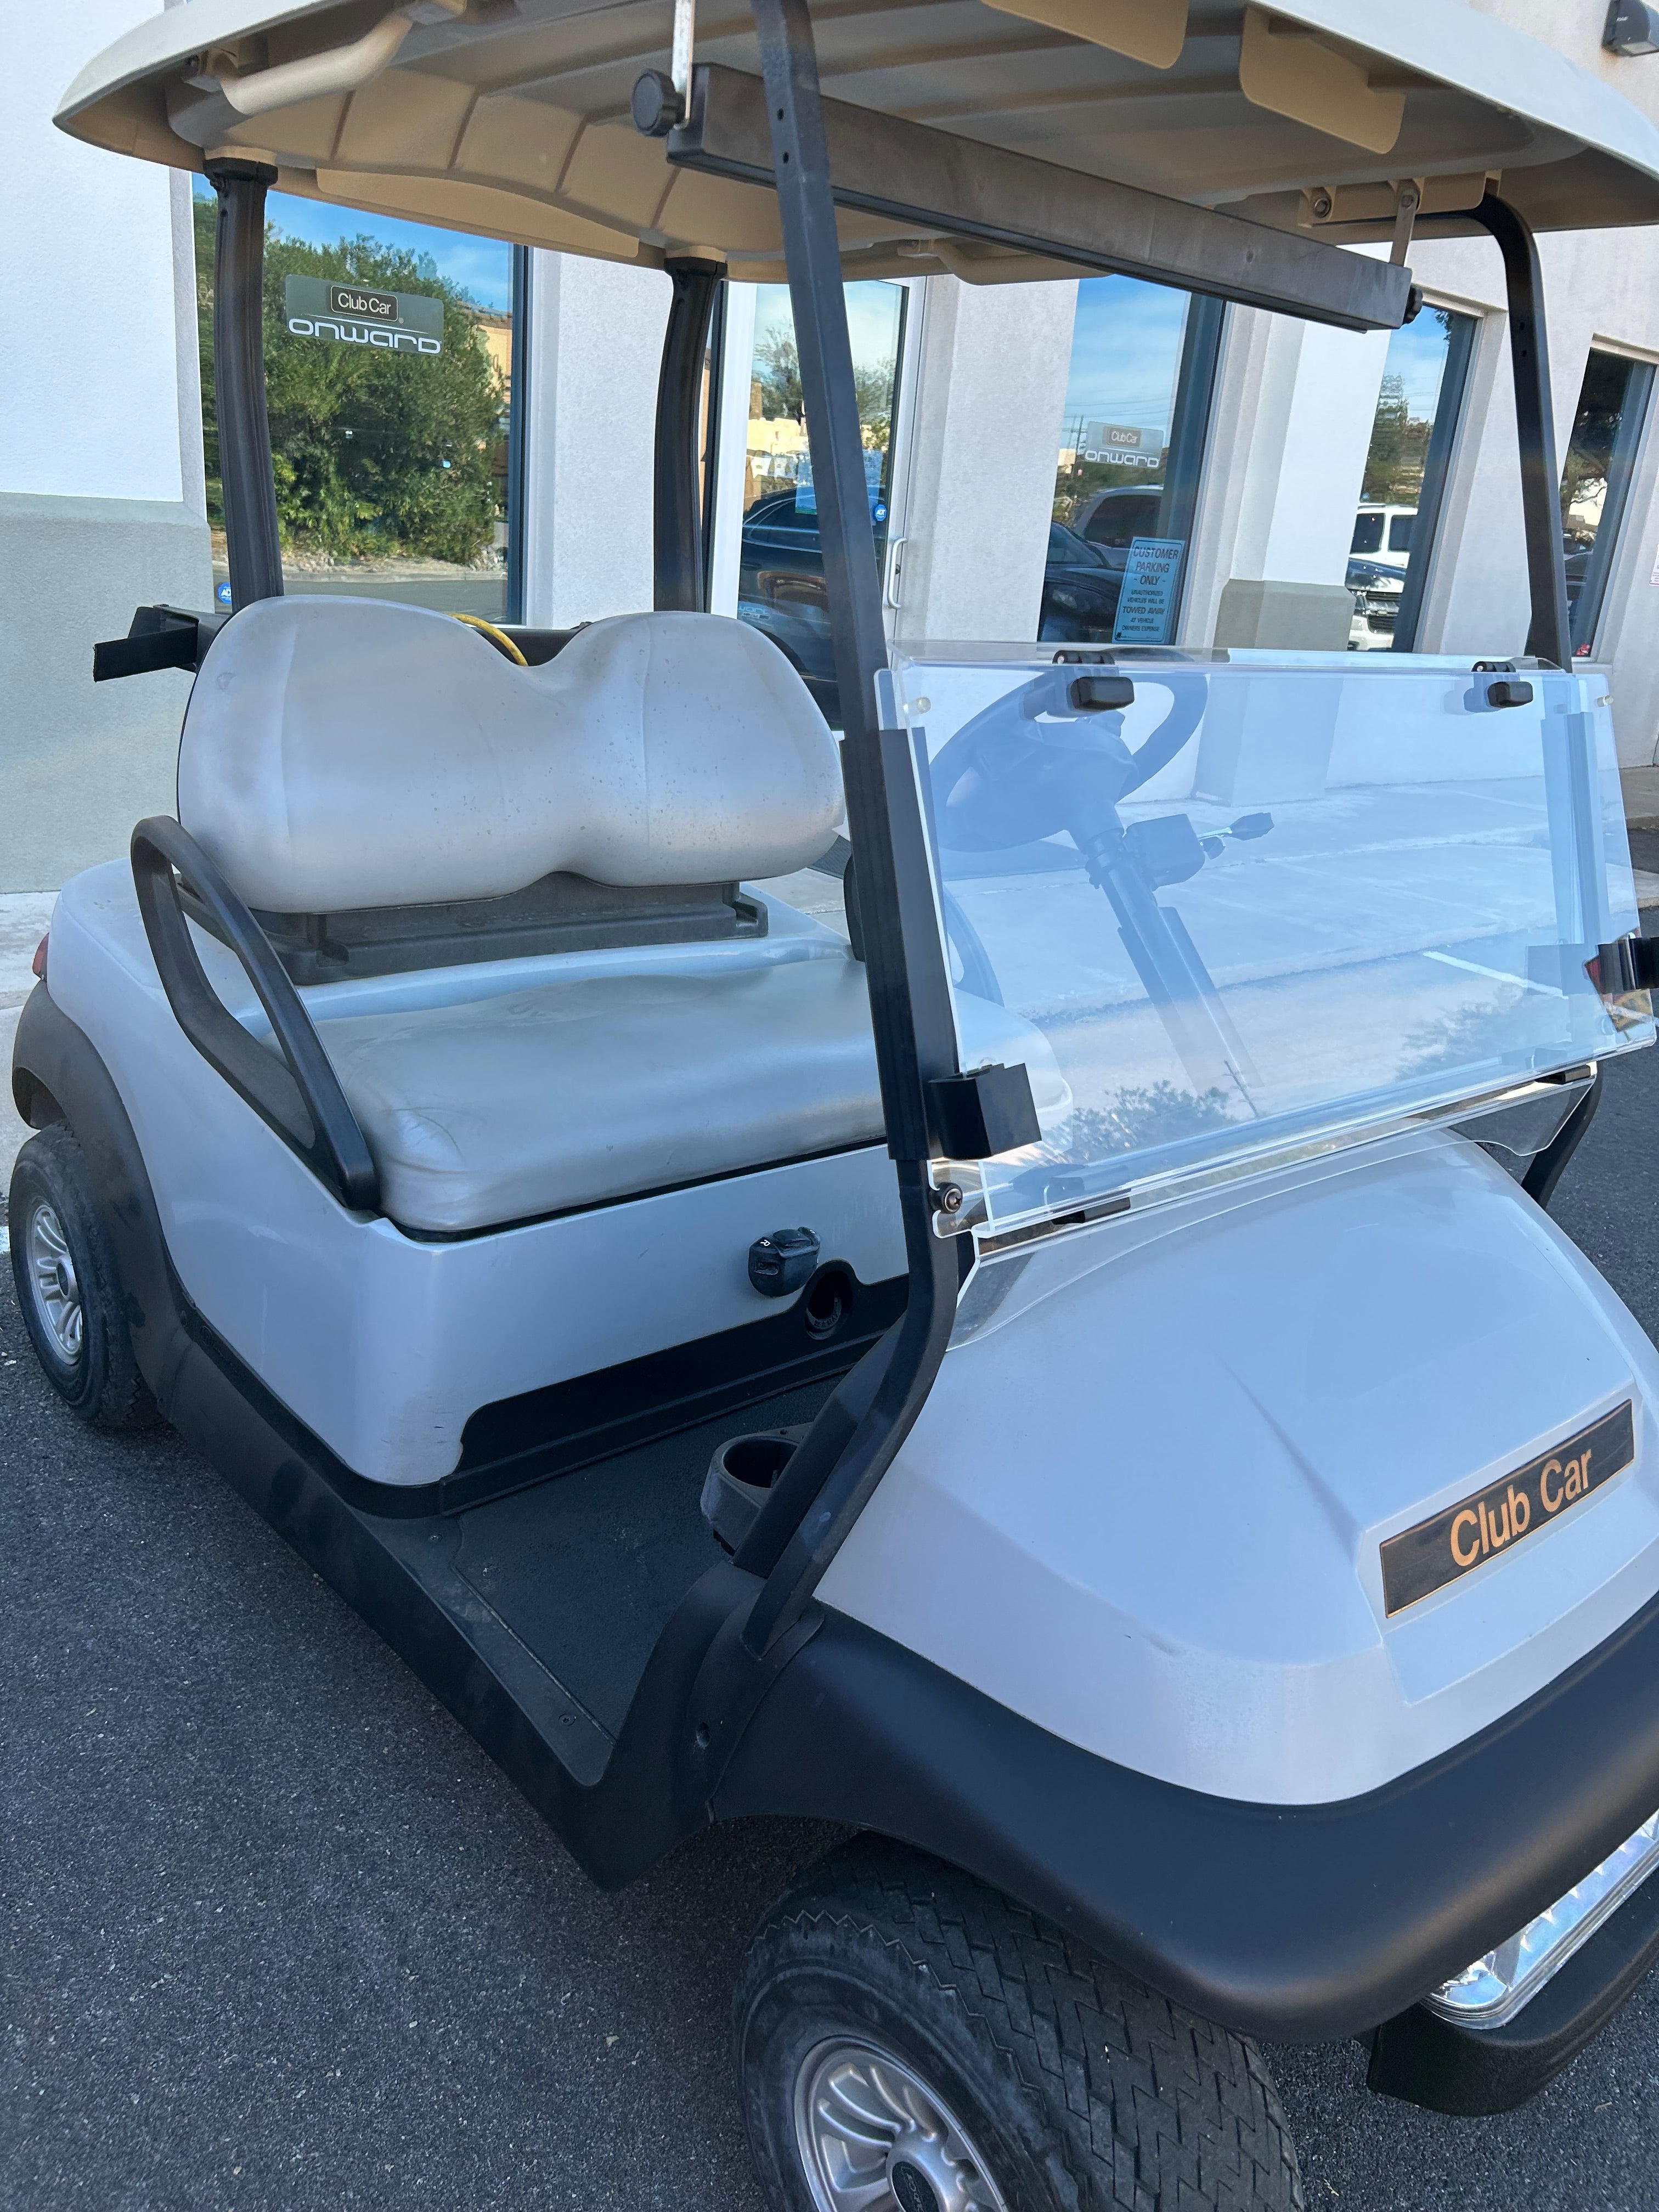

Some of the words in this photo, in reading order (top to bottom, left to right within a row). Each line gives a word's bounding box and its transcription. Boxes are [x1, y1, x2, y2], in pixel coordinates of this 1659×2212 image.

[338, 292, 368, 311] Club
[369, 298, 392, 315] Car
[1133, 546, 1179, 559] CUSTOMER
[1136, 561, 1170, 573] PARKING
[1140, 575, 1161, 585] ONLY
[1450, 1484, 1531, 1567] Club
[1539, 1448, 1592, 1513] Car
